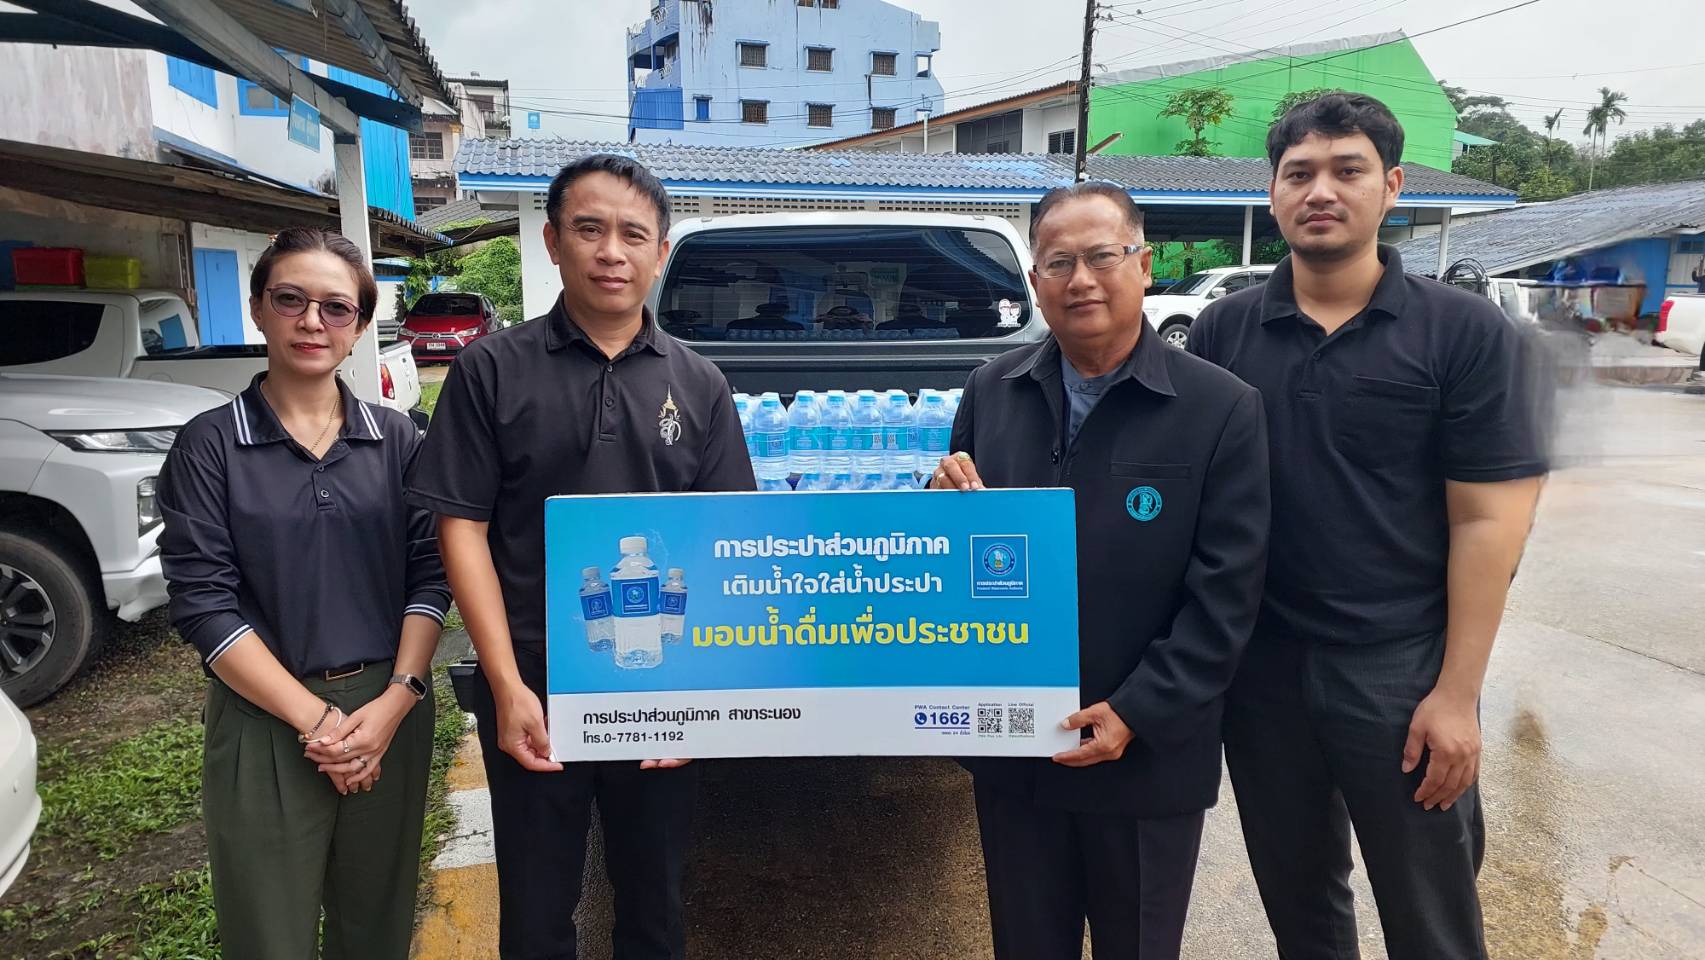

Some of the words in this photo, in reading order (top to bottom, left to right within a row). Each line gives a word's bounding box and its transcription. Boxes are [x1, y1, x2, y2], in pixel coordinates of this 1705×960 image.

[714, 532, 950, 562] การประปาส่วนภูมิภาค
[723, 564, 943, 596] เติมน้ำใจใส่น้ำประปา
[692, 606, 1030, 647] มอบน้ำดื่มเพื่อประชาชน
[583, 707, 720, 726] การประปาส่วนภูมิภาค
[728, 707, 802, 721] สาขาระนอง
[929, 712, 971, 725] 1662
[583, 730, 685, 744] โทร.0-7781-1192
